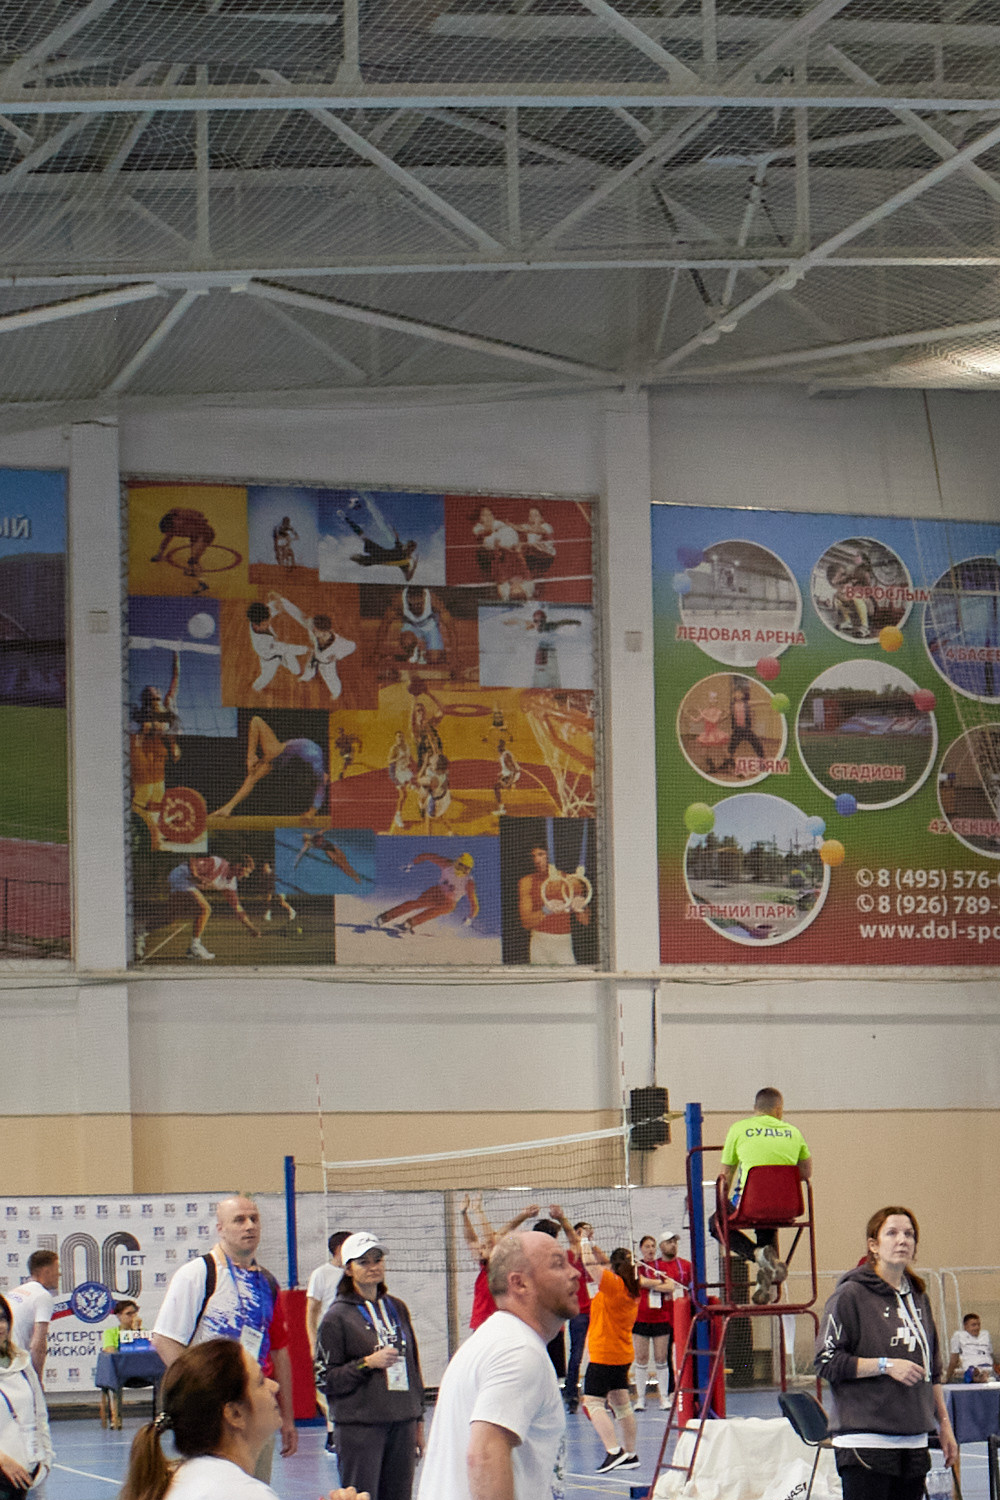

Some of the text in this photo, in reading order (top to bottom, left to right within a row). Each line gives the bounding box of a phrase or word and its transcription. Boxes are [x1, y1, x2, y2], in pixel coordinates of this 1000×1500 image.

[845, 586, 931, 601] ВЗРОСЛЫМ
[676, 625, 805, 645] ЛЕДОВАЯ АРЕНА
[735, 758, 790, 774] ДЕТЯМ
[830, 764, 905, 782] СТАДИОН
[929, 819, 949, 834] 42
[876, 869, 891, 888] 8
[895, 868, 948, 891] (495)
[687, 903, 797, 919] ЛЕТНИЙ ПАРК
[877, 895, 891, 914] 8
[896, 894, 948, 917] (926)
[745, 1128, 792, 1139] СУДЬЯ
[120, 1254, 147, 1266] ЛЕТ
[47, 1331, 104, 1343] ИСТЕРСТ
